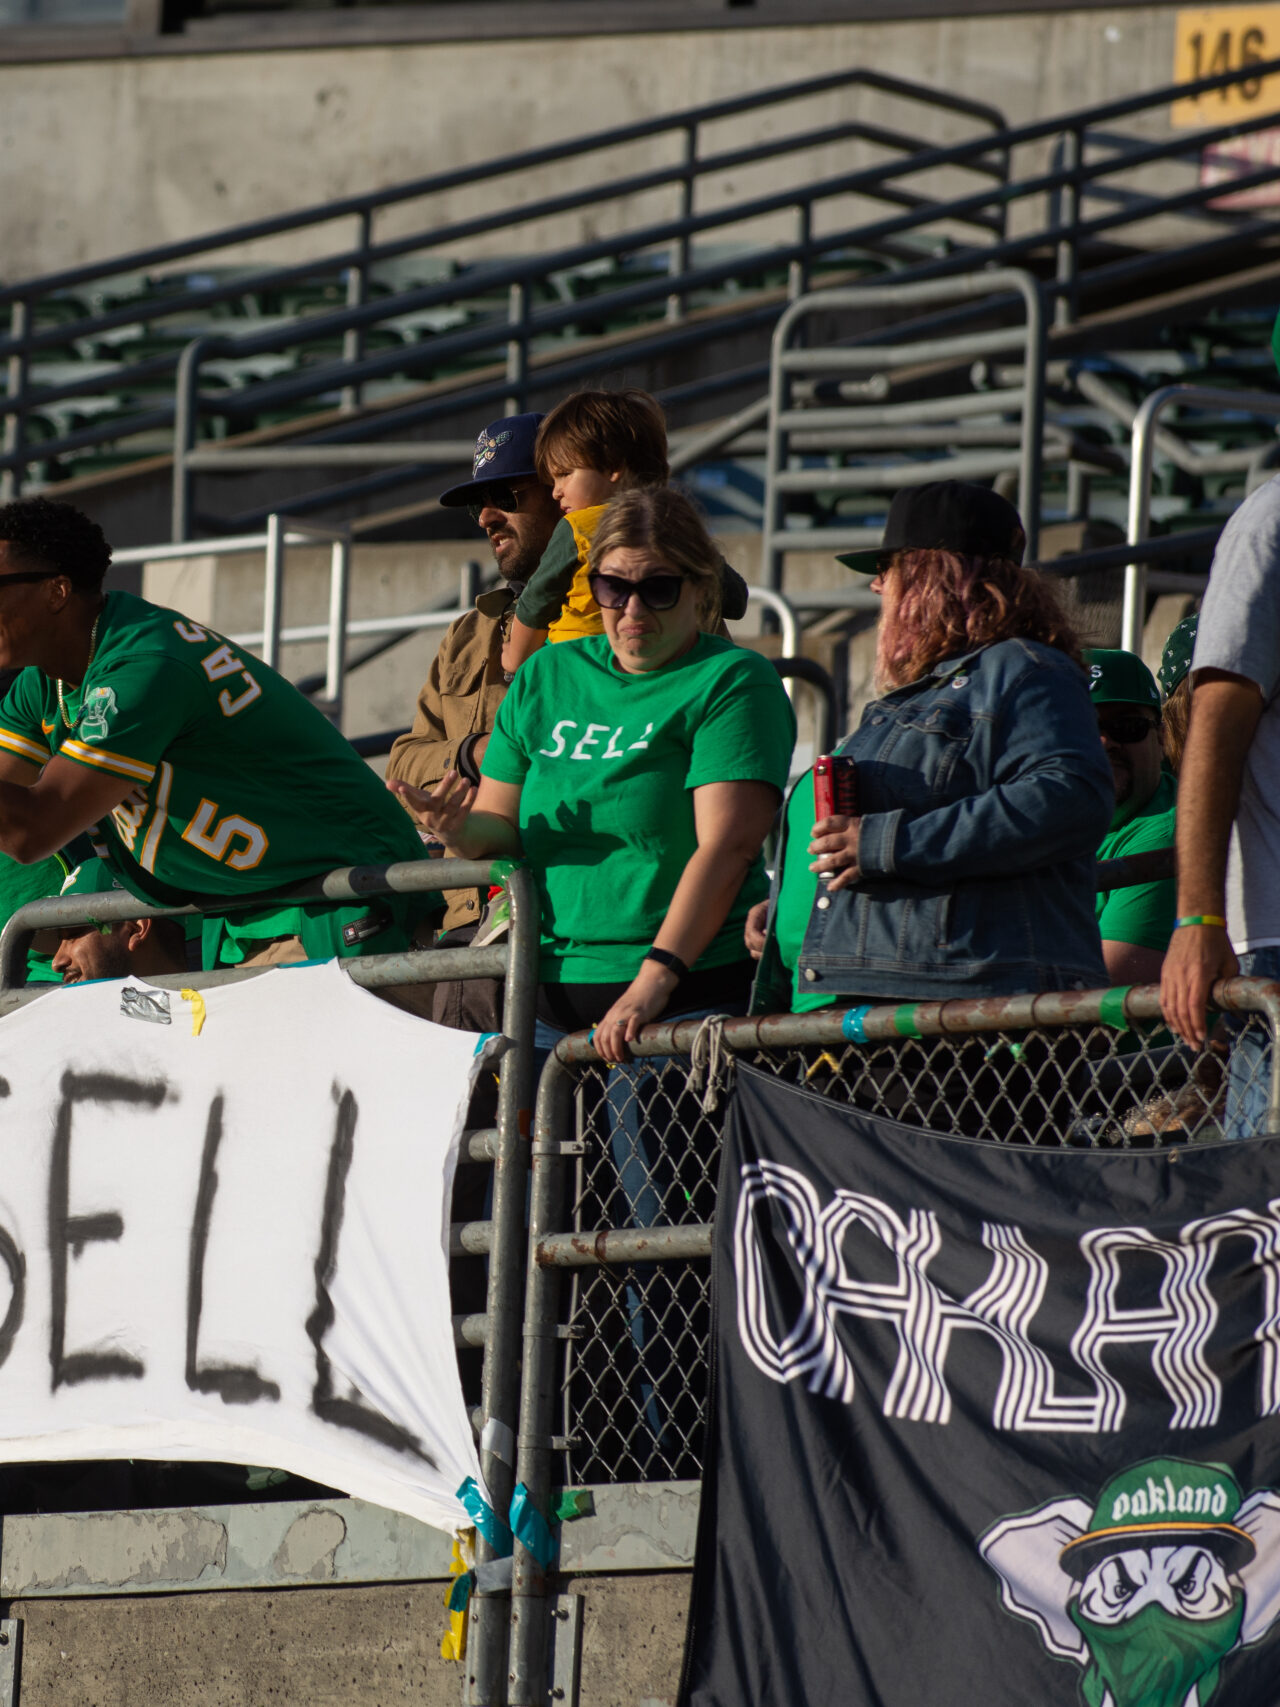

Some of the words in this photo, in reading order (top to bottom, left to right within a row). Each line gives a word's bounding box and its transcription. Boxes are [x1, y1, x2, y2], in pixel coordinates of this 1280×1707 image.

[181, 798, 269, 871] 5
[734, 1158, 1280, 1433] OAKLAN
[1111, 1475, 1228, 1521] oakland
